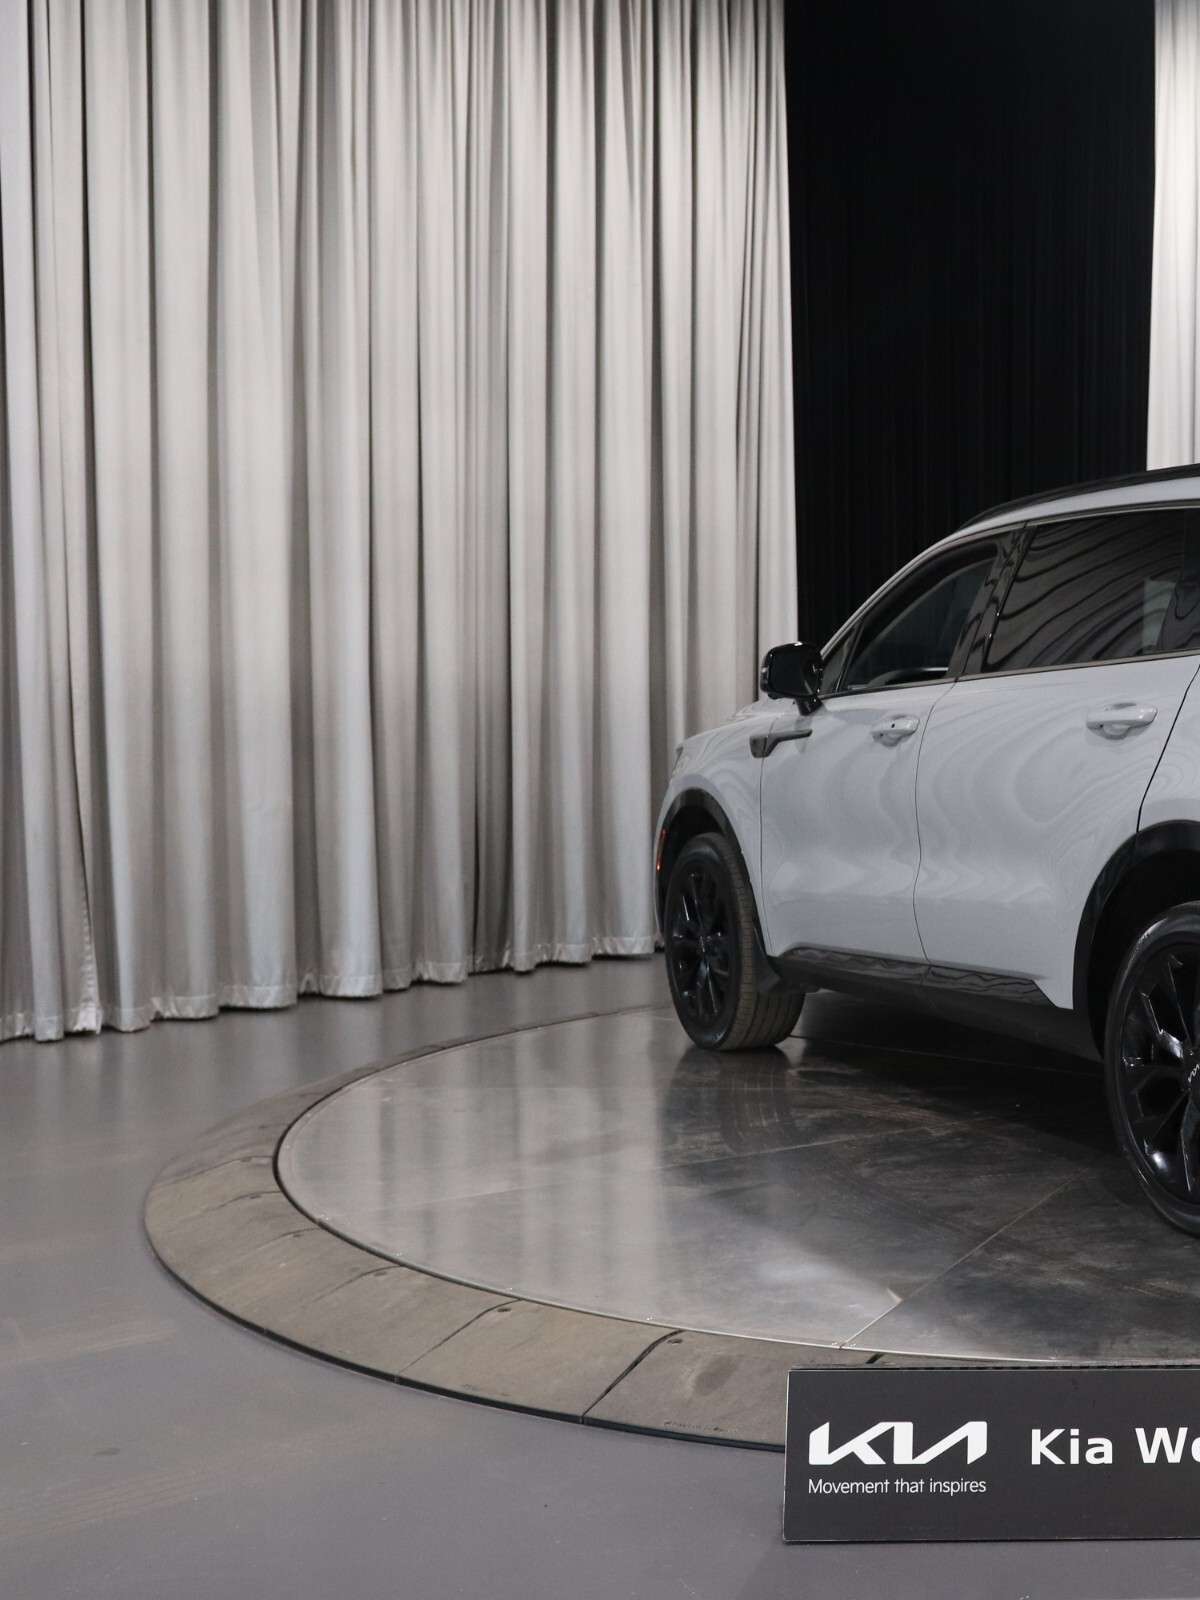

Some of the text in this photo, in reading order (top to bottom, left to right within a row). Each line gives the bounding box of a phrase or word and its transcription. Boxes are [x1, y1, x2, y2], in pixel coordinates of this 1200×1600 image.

[808, 1421, 988, 1466] KIA
[1031, 1429, 1113, 1465] Kia
[808, 1478, 987, 1497] Movement that inspires
